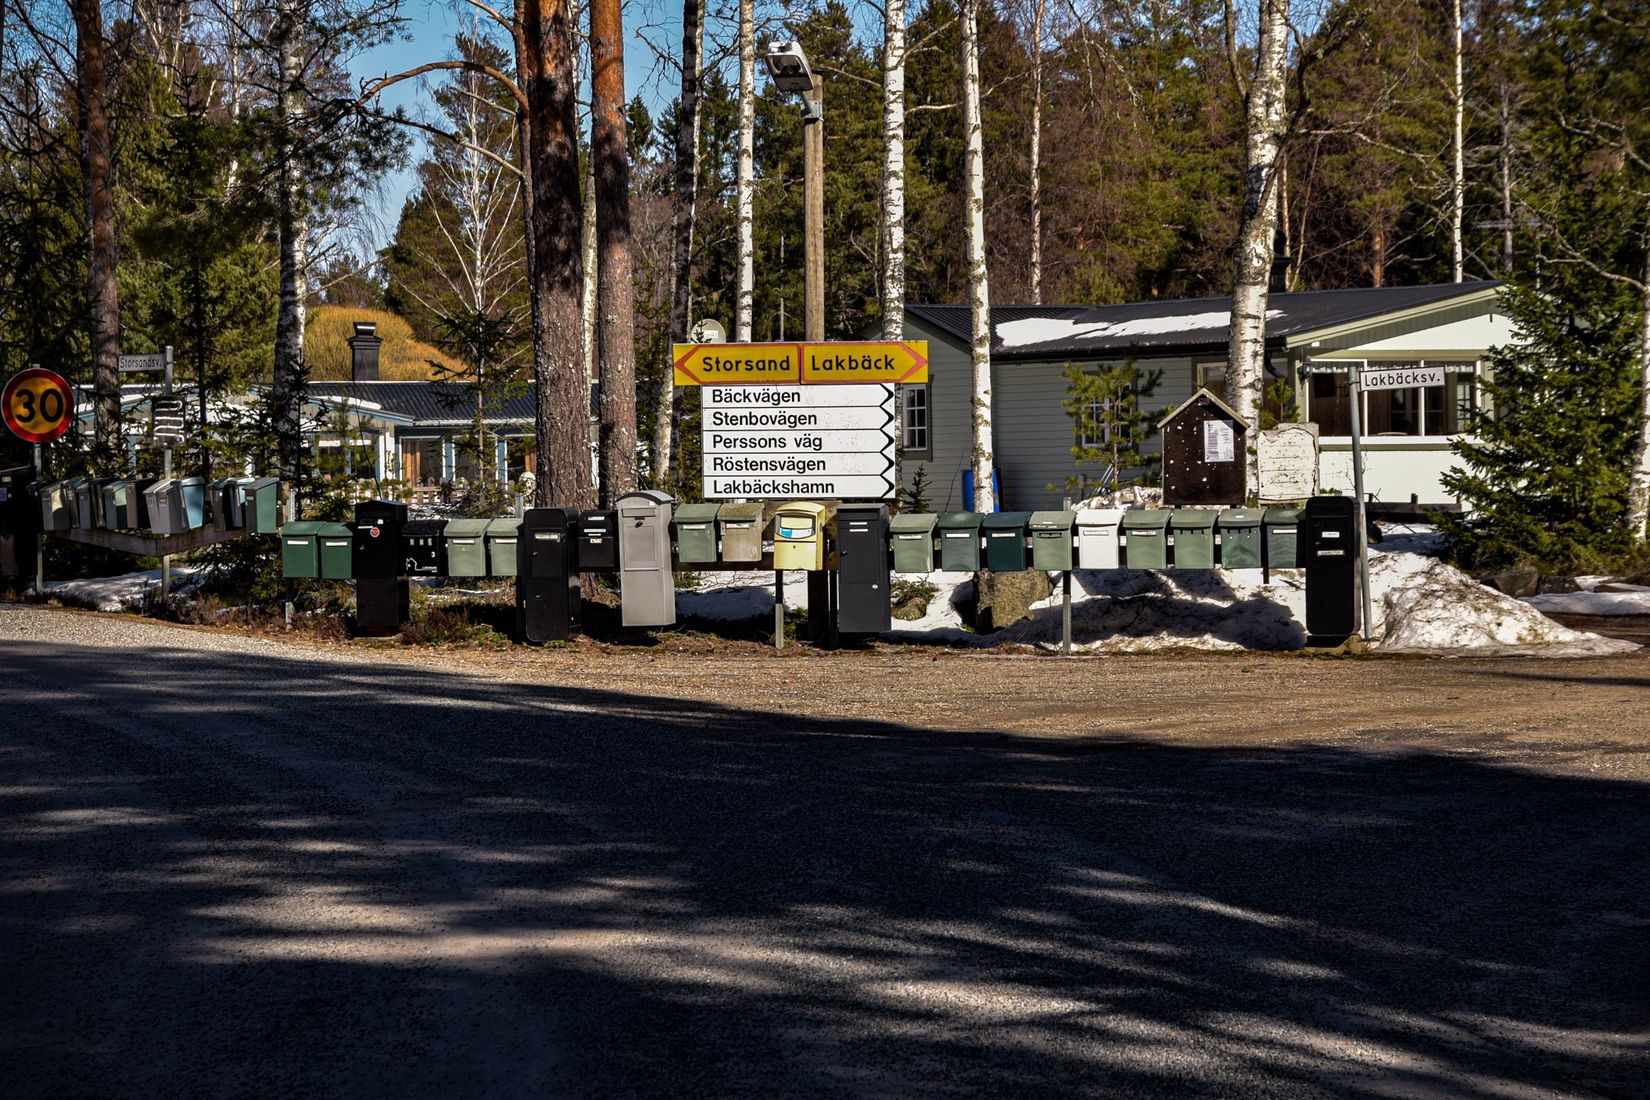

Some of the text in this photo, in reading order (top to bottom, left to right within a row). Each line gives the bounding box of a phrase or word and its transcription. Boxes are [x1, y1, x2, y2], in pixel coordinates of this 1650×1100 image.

[702, 355, 790, 372] Storsand
[811, 354, 895, 371] Lakbäck
[1365, 371, 1440, 387] Lakbäcksv.
[712, 388, 801, 405] Bäckvägen
[16, 388, 64, 423] 30
[712, 411, 817, 428] Stenbovägen
[712, 434, 822, 451] Perssons väg
[713, 456, 826, 474] Röstensvägen
[713, 479, 835, 494] Lakbäckshamn
